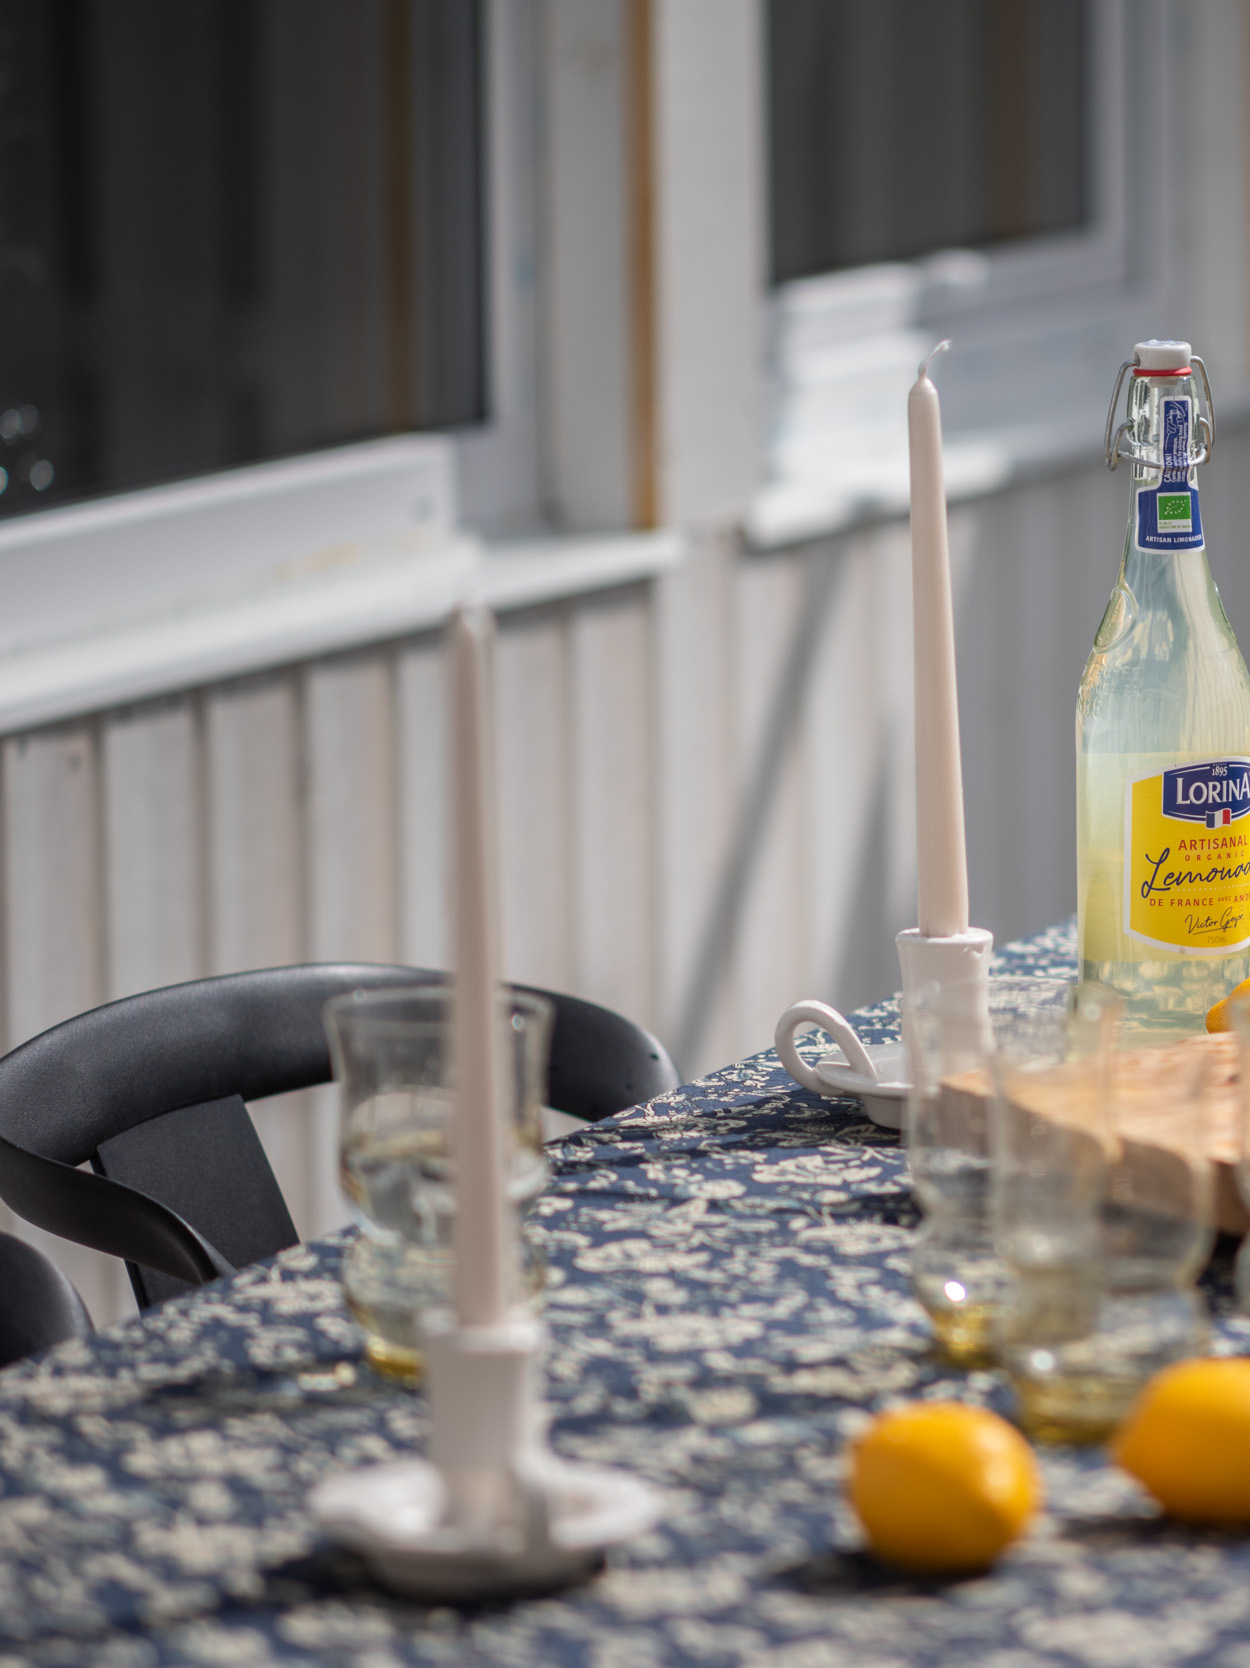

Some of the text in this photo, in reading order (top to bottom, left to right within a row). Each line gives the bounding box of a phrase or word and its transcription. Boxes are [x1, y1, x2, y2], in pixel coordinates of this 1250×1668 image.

[1145, 535, 1172, 543] ARTISAN
[1212, 766, 1228, 777] 1895
[1178, 834, 1248, 851] ARTISANAL
[1184, 850, 1244, 861] ORGANIC
[1149, 898, 1164, 907] DE
[1170, 897, 1214, 907] FRANCE
[1217, 895, 1232, 903] AVEC
[1185, 914, 1218, 934] Victor
